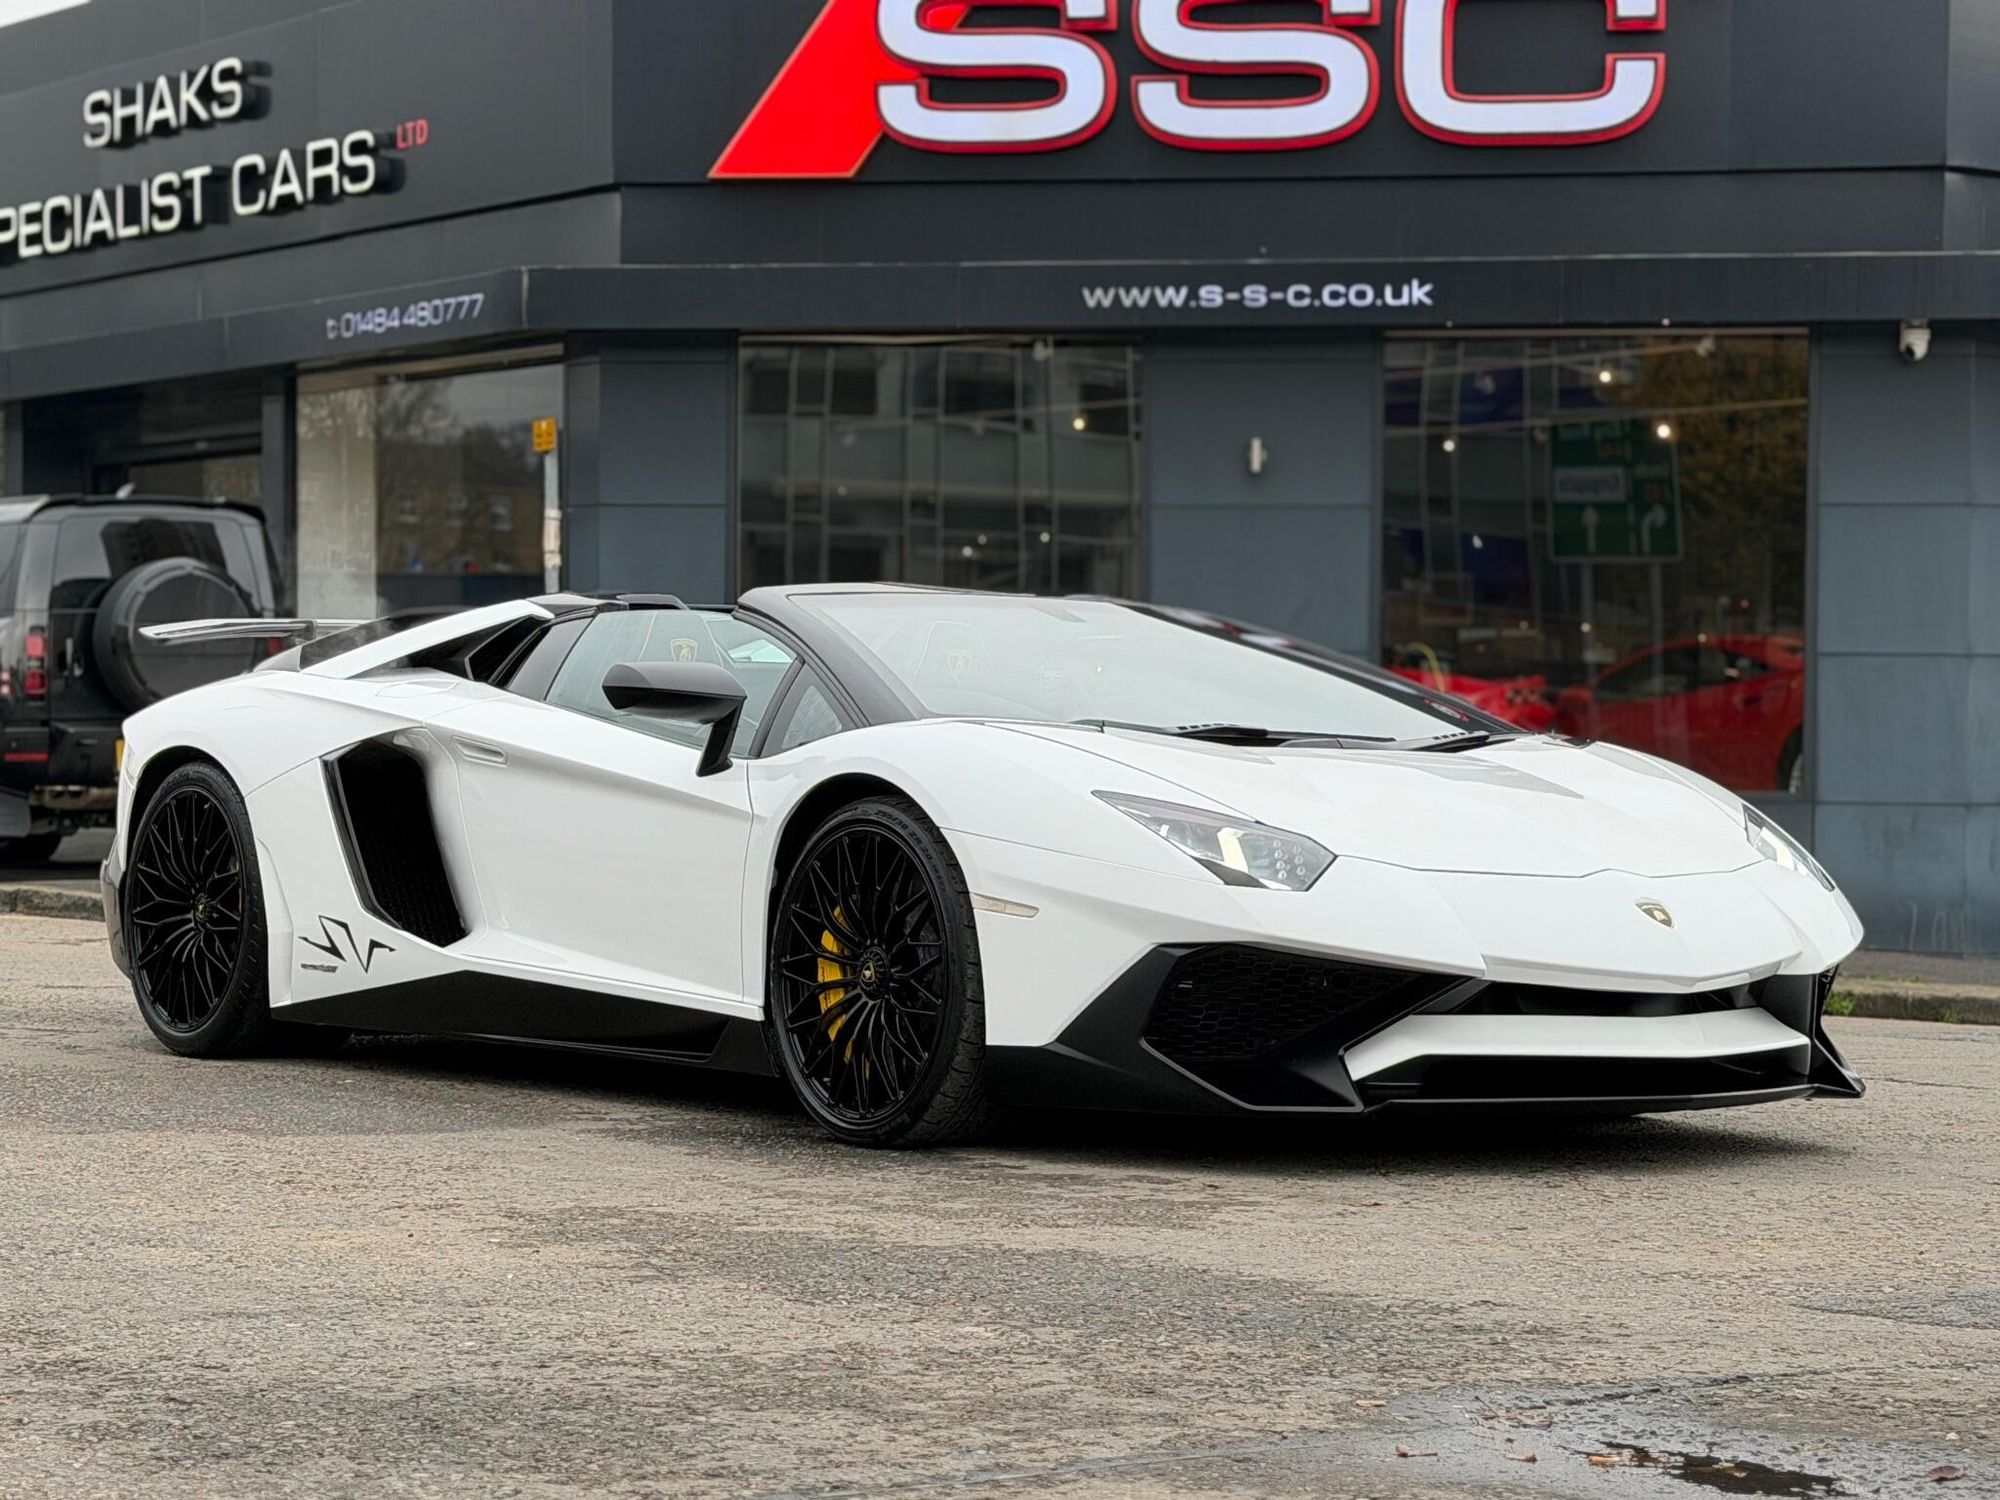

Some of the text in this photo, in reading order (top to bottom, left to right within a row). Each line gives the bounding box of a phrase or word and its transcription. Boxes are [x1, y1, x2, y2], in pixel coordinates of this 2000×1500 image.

[82, 56, 243, 148] SHAKS
[876, 0, 1667, 153] SSC
[232, 129, 376, 215] CARS
[396, 117, 429, 150] LTD
[402, 291, 485, 328] 480777
[1081, 277, 1435, 309] www.s-s-c.co.uk
